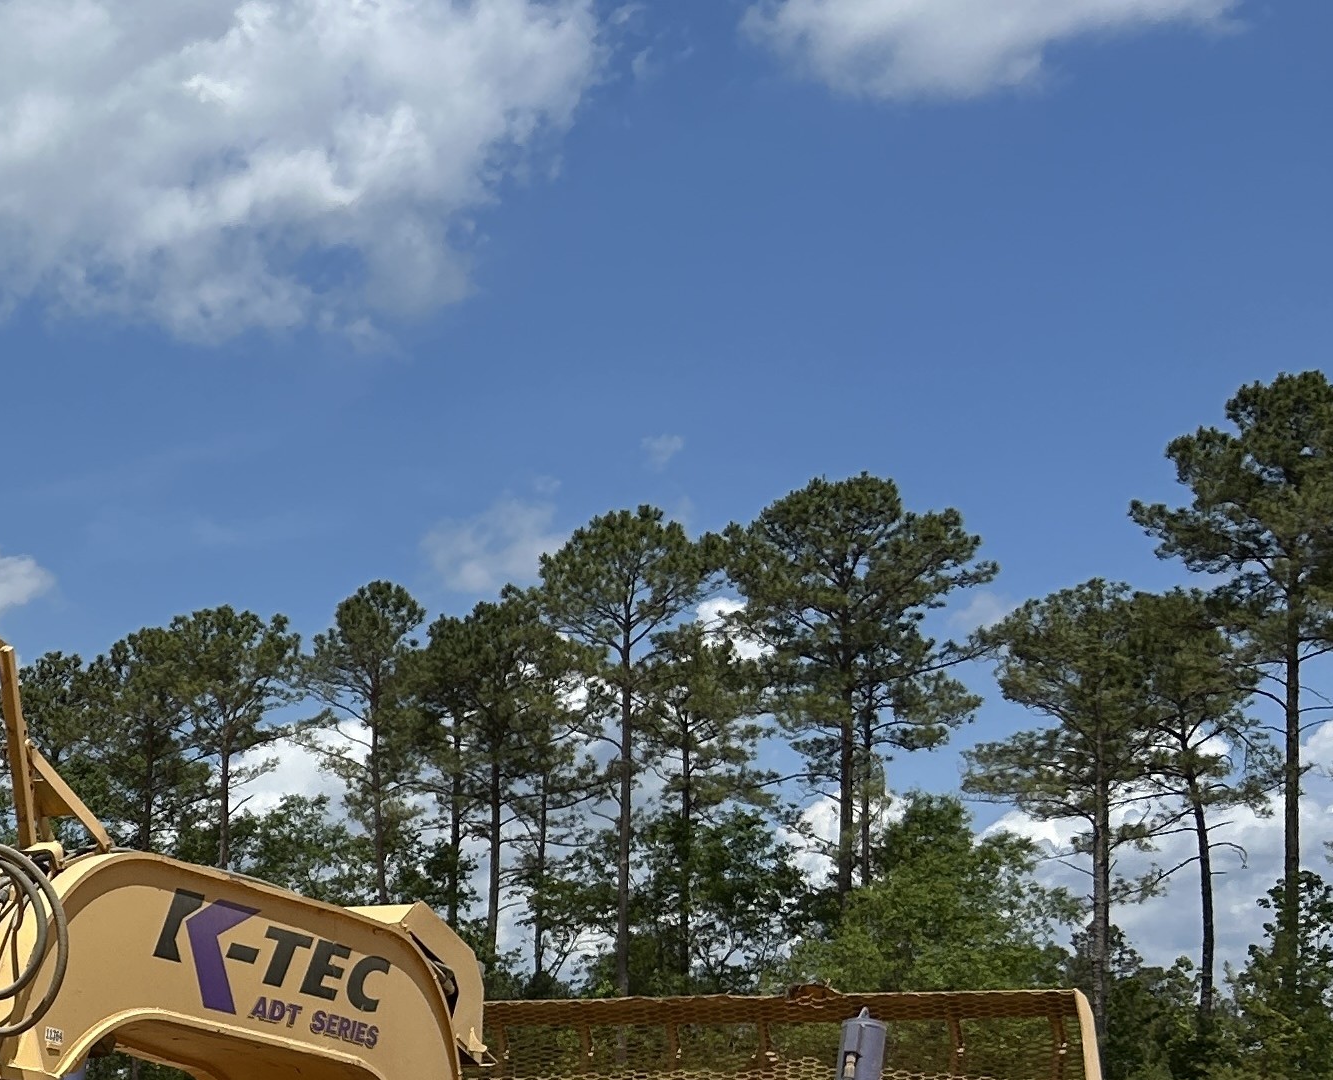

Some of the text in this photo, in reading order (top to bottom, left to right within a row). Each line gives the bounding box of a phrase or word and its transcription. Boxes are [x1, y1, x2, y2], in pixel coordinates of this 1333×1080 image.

[153, 888, 391, 1015] K-TEC
[247, 997, 379, 1049] ADT SERIES
